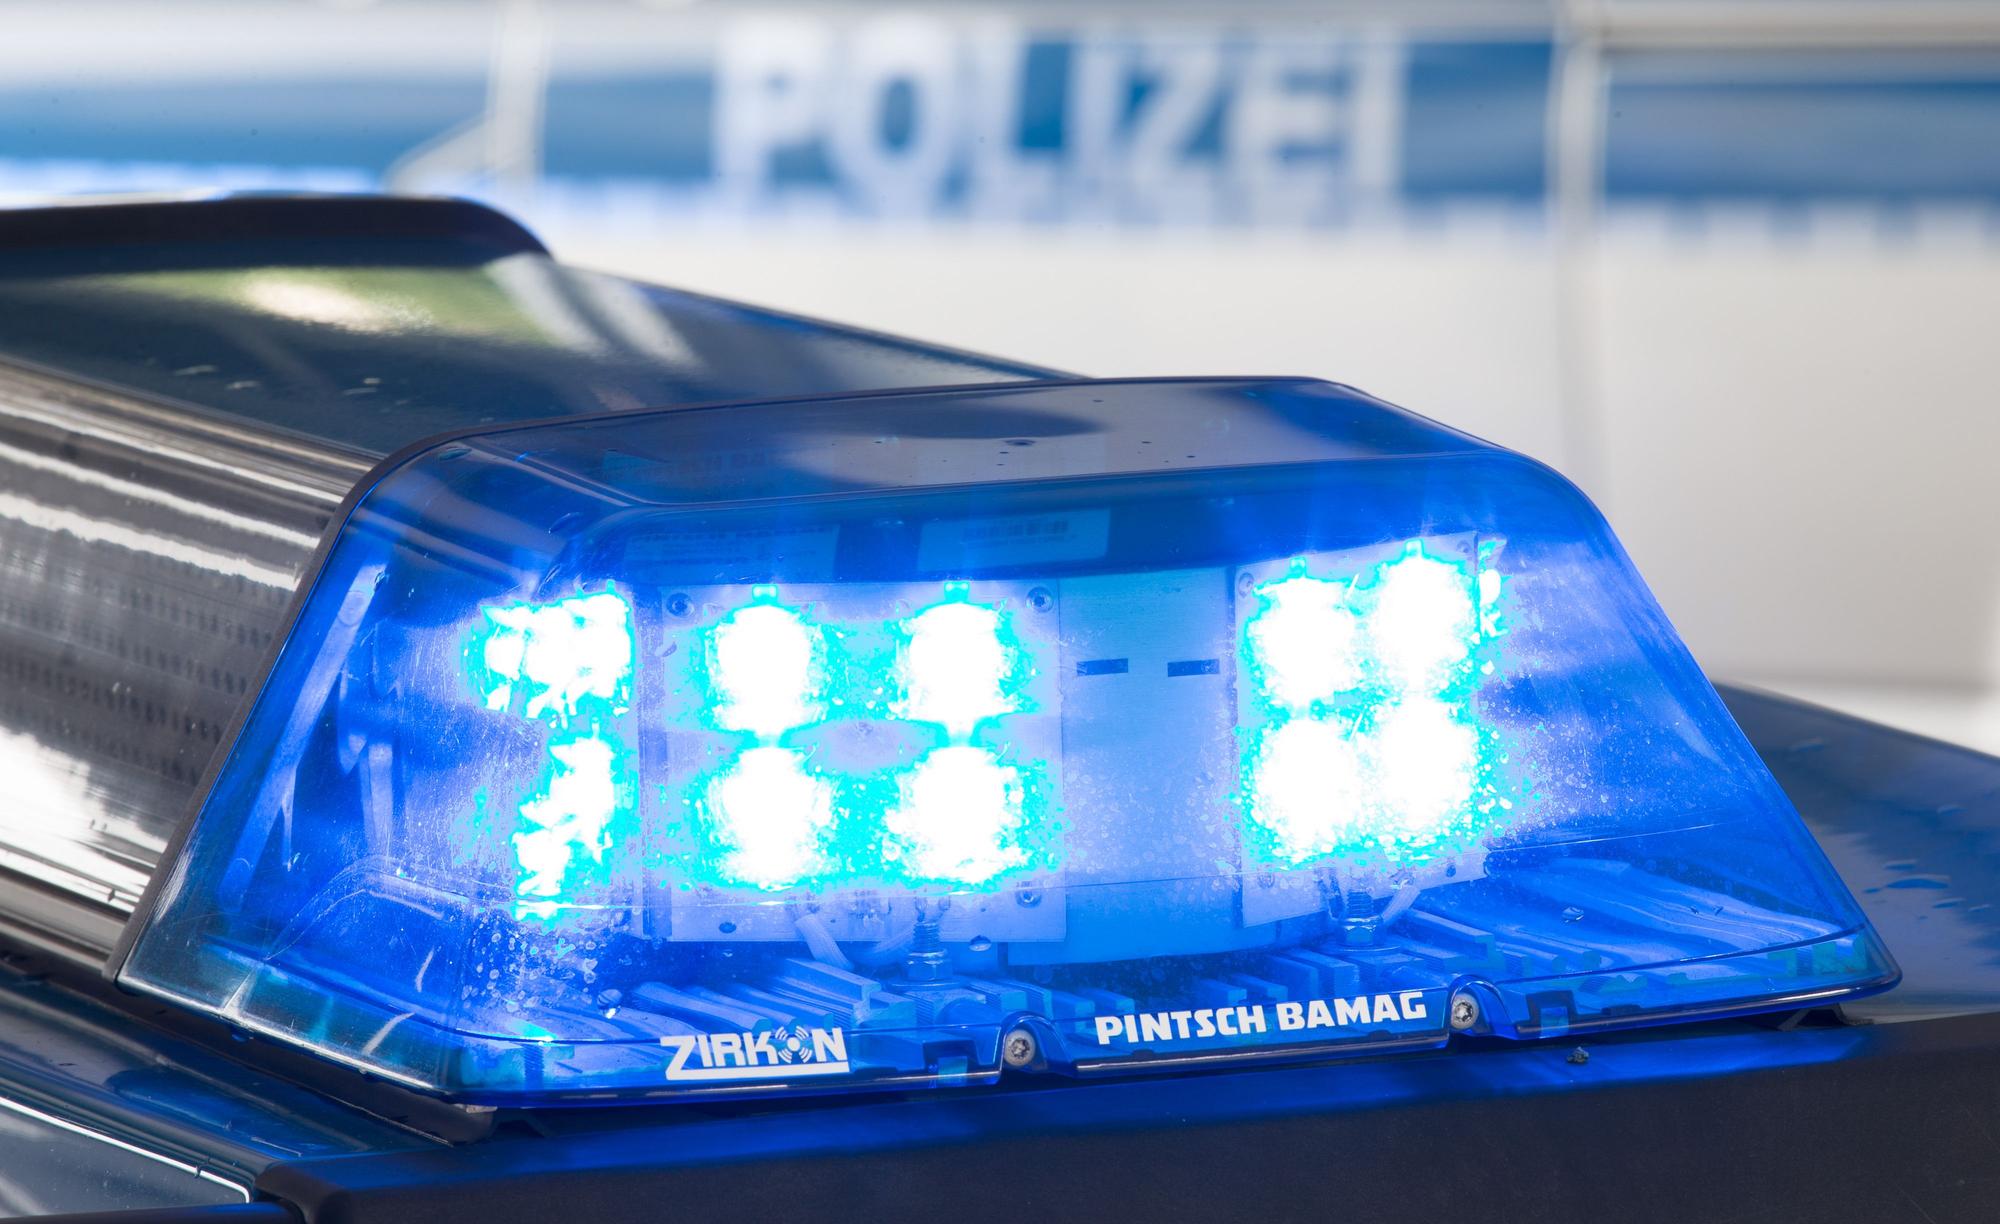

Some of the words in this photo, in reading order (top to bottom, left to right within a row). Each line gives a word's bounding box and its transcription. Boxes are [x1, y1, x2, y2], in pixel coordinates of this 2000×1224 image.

[710, 20, 1405, 206] POLIZEI
[1094, 1004, 1267, 1045] PINTSCH
[1276, 990, 1427, 1031] BAMAG
[660, 1026, 850, 1080] ZIRKON
